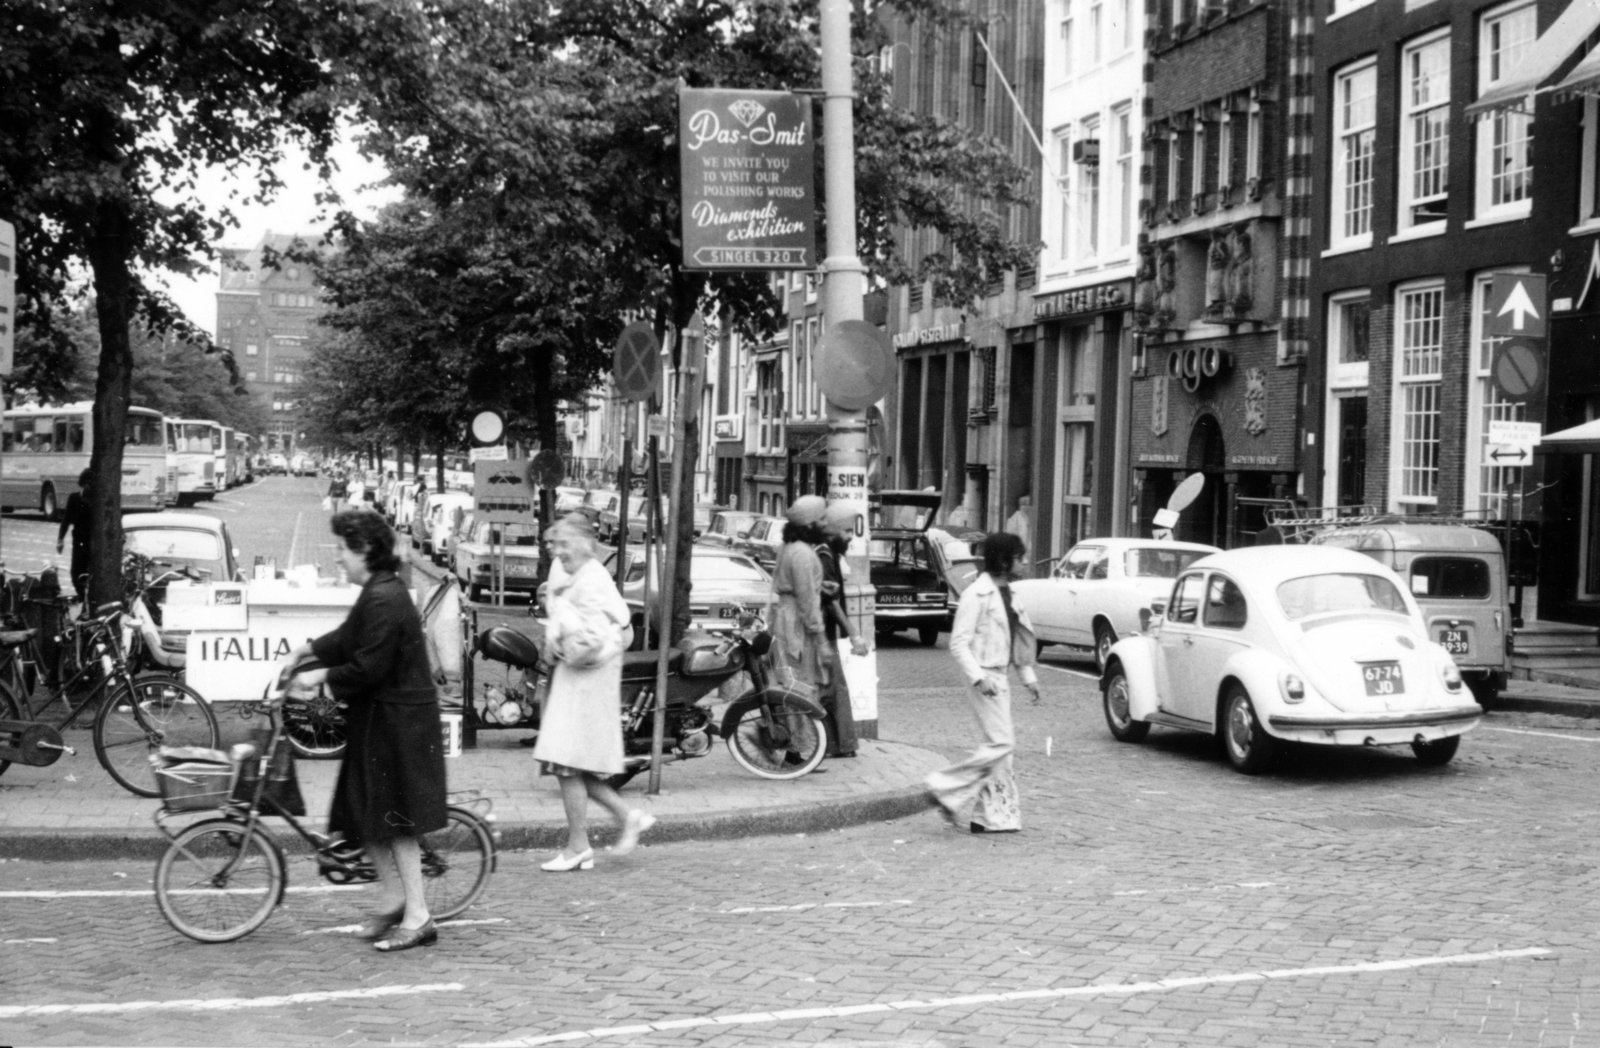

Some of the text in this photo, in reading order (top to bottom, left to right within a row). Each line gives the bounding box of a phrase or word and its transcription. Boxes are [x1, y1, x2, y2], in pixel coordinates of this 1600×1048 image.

[688, 109, 806, 150] Pas-Smit
[702, 157, 790, 173] WE INVITE YOU
[703, 171, 779, 183] TO VISIT OUR
[703, 186, 805, 198] POLISHING WORKS
[691, 200, 779, 227] Diamonds
[726, 217, 806, 242] exhibition
[711, 251, 791, 263] SINGEL 320
[838, 473, 865, 488] SIEN
[1447, 631, 1461, 641] ZN
[1365, 665, 1402, 682] 67-74
